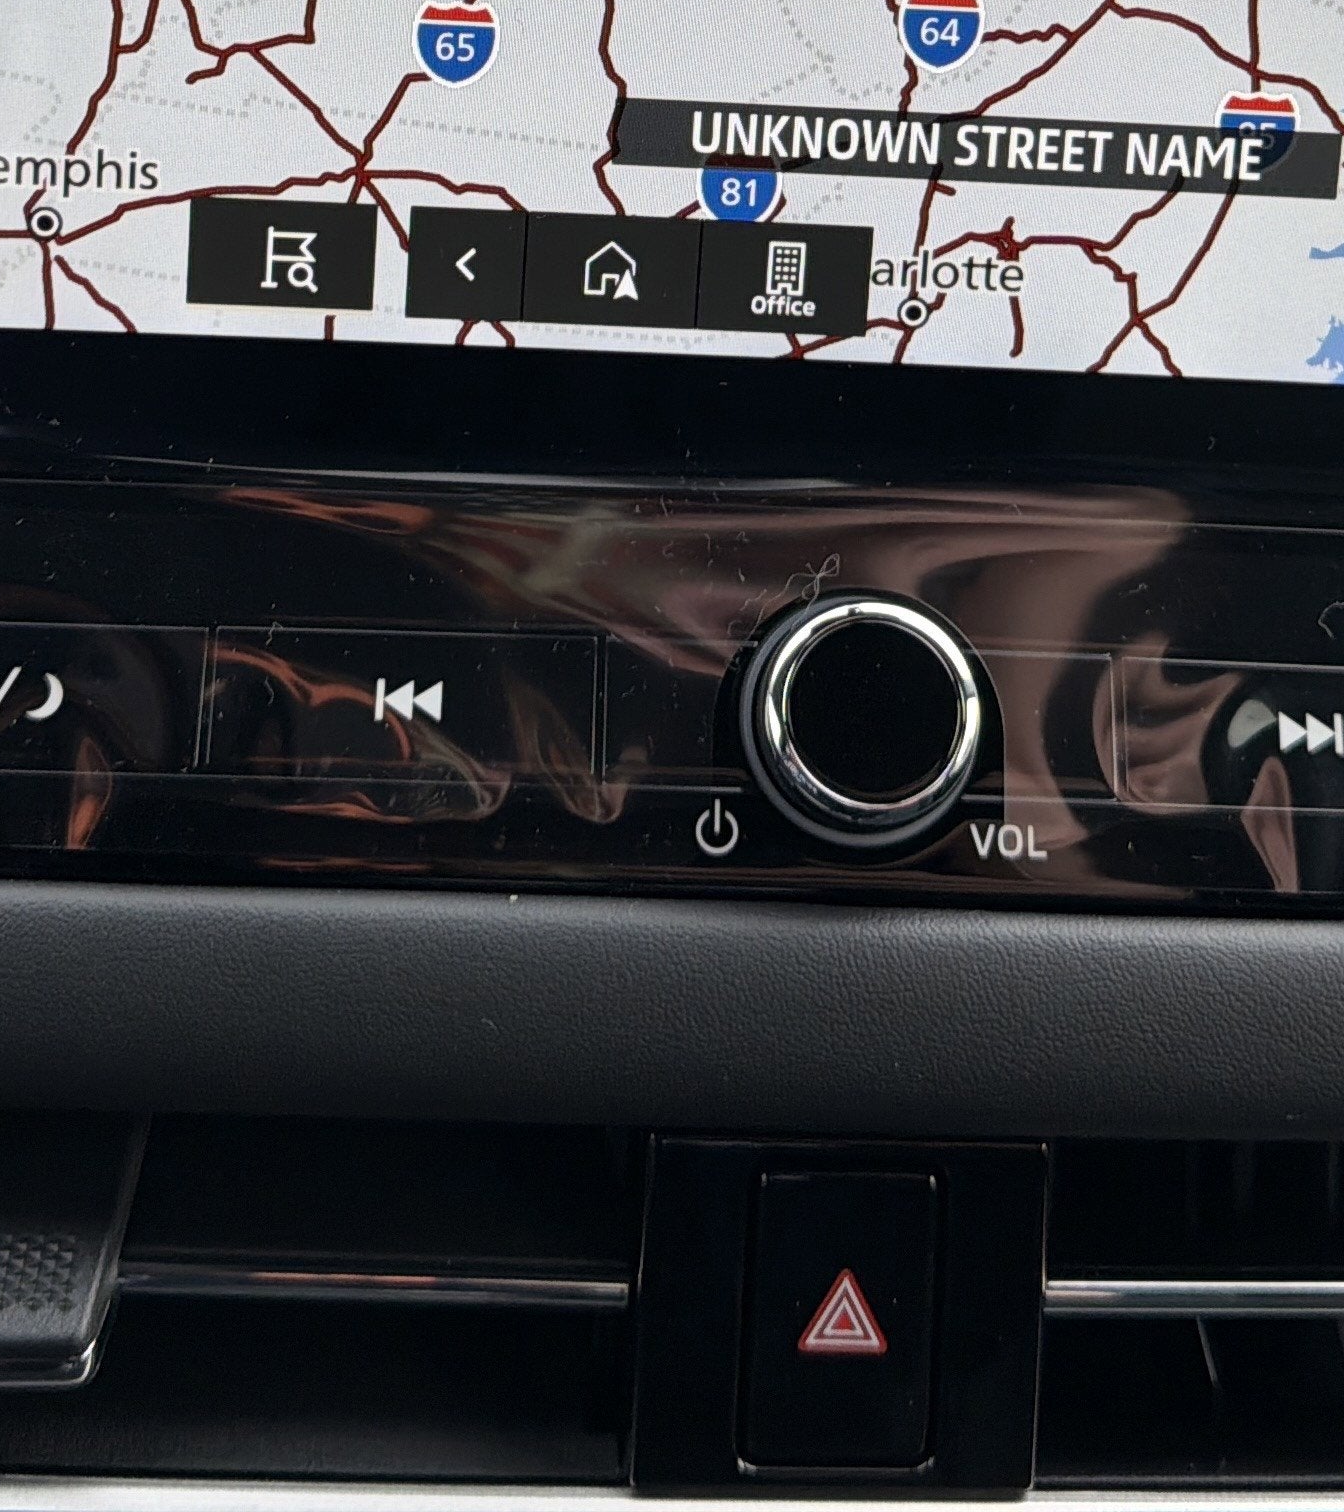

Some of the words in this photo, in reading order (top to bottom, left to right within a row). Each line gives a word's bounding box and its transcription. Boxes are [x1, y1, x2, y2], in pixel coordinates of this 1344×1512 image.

[434, 32, 476, 63] 65
[919, 16, 961, 48] 64
[691, 110, 942, 165] UNKNOWN
[954, 123, 1114, 174] STREET
[1125, 134, 1263, 181] NAME
[720, 176, 758, 208] 81
[871, 249, 1024, 292] arlotte
[750, 293, 816, 318] Office
[971, 822, 1048, 860] VOL
